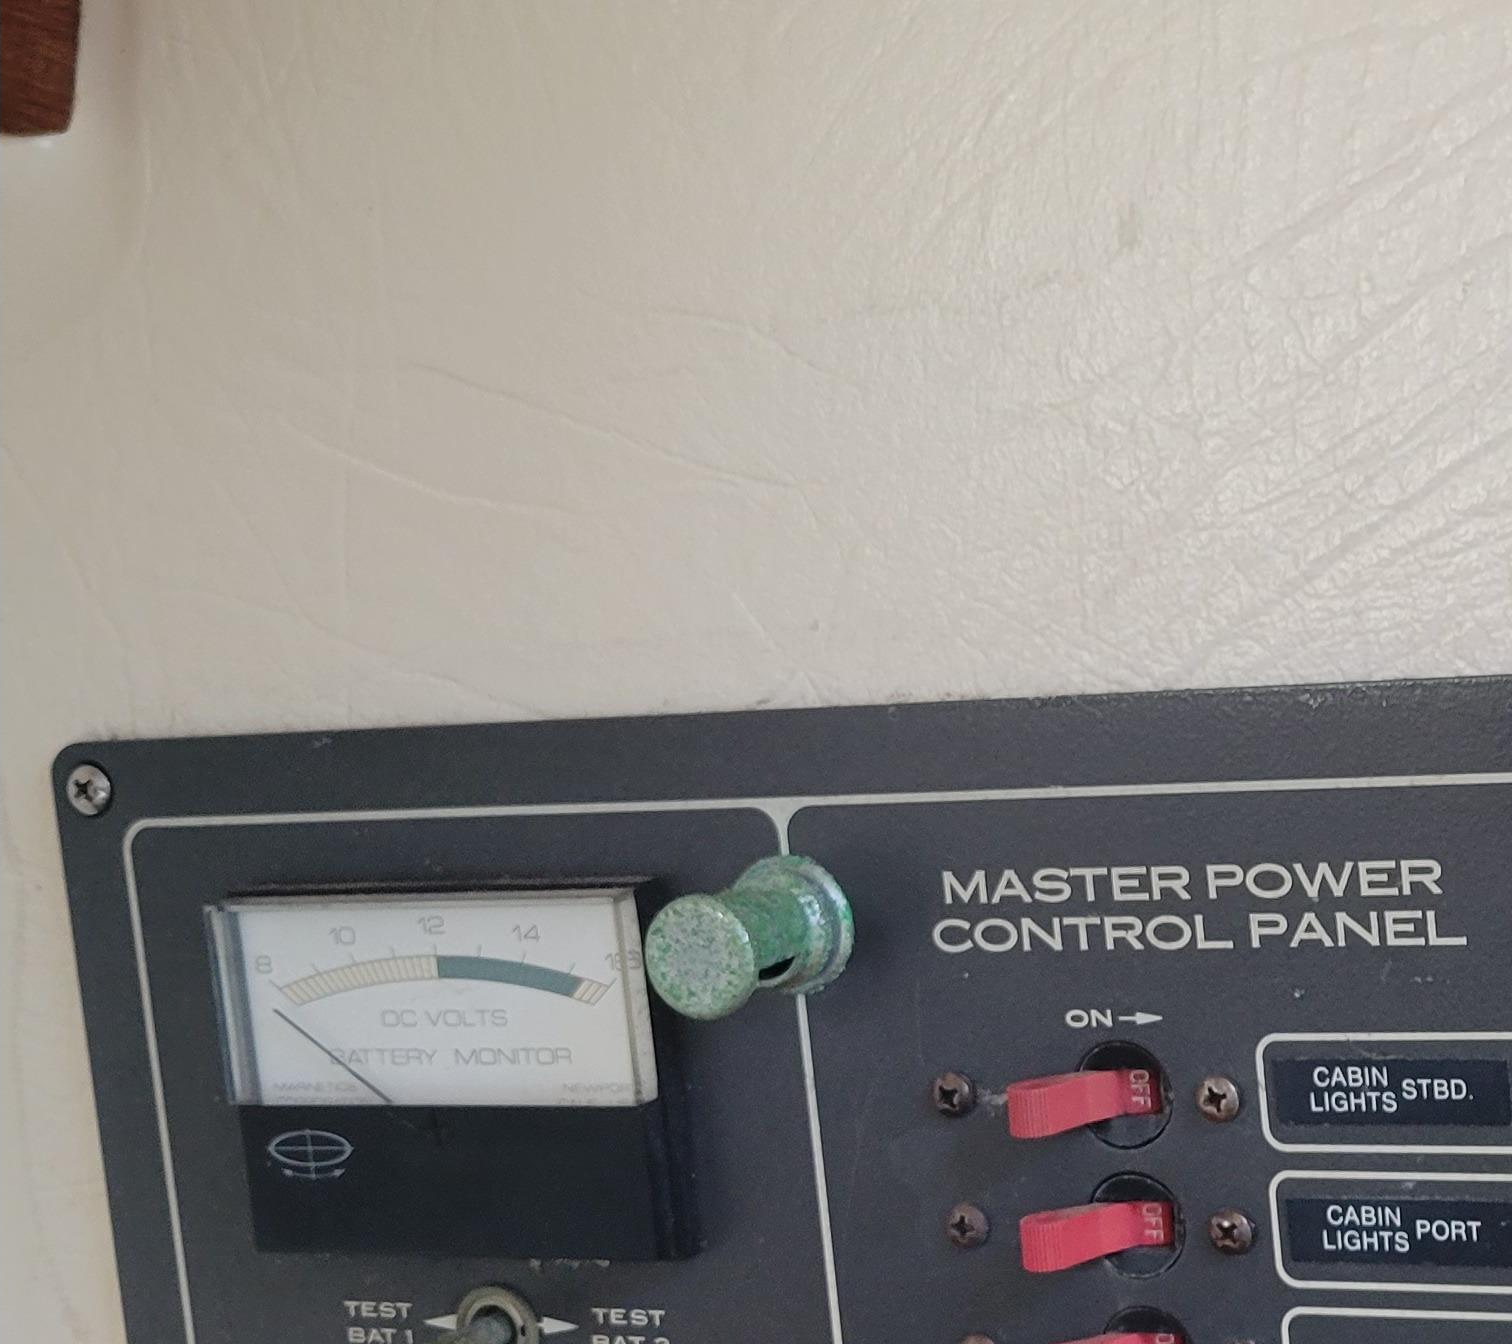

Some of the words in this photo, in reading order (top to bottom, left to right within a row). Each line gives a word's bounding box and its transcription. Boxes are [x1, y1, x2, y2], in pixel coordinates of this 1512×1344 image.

[941, 865, 1192, 905] MASTER
[1206, 858, 1444, 901] POWER
[328, 926, 356, 946] 10
[417, 915, 446, 935] 12
[512, 924, 541, 944] 14
[931, 913, 1235, 953] CONTROL
[1249, 909, 1468, 949] PANEL
[254, 955, 273, 974] 8
[380, 1009, 419, 1027] DC
[427, 1008, 508, 1027] VOLTS
[1064, 1008, 1113, 1028] ON
[329, 1046, 437, 1066] BATTERY
[454, 1046, 572, 1066] MONITOR
[1312, 1066, 1389, 1088] CABIN
[1129, 1069, 1151, 1111] OFF
[1401, 1078, 1474, 1101] STBD.
[1310, 1090, 1398, 1113] LIGHTS
[1142, 1205, 1165, 1245] OFF
[1326, 1204, 1401, 1227] CABIN
[1322, 1229, 1410, 1253] LIGHTS
[1415, 1219, 1482, 1243] PORT
[344, 1299, 412, 1319] TEST
[593, 1307, 666, 1328] TEST
